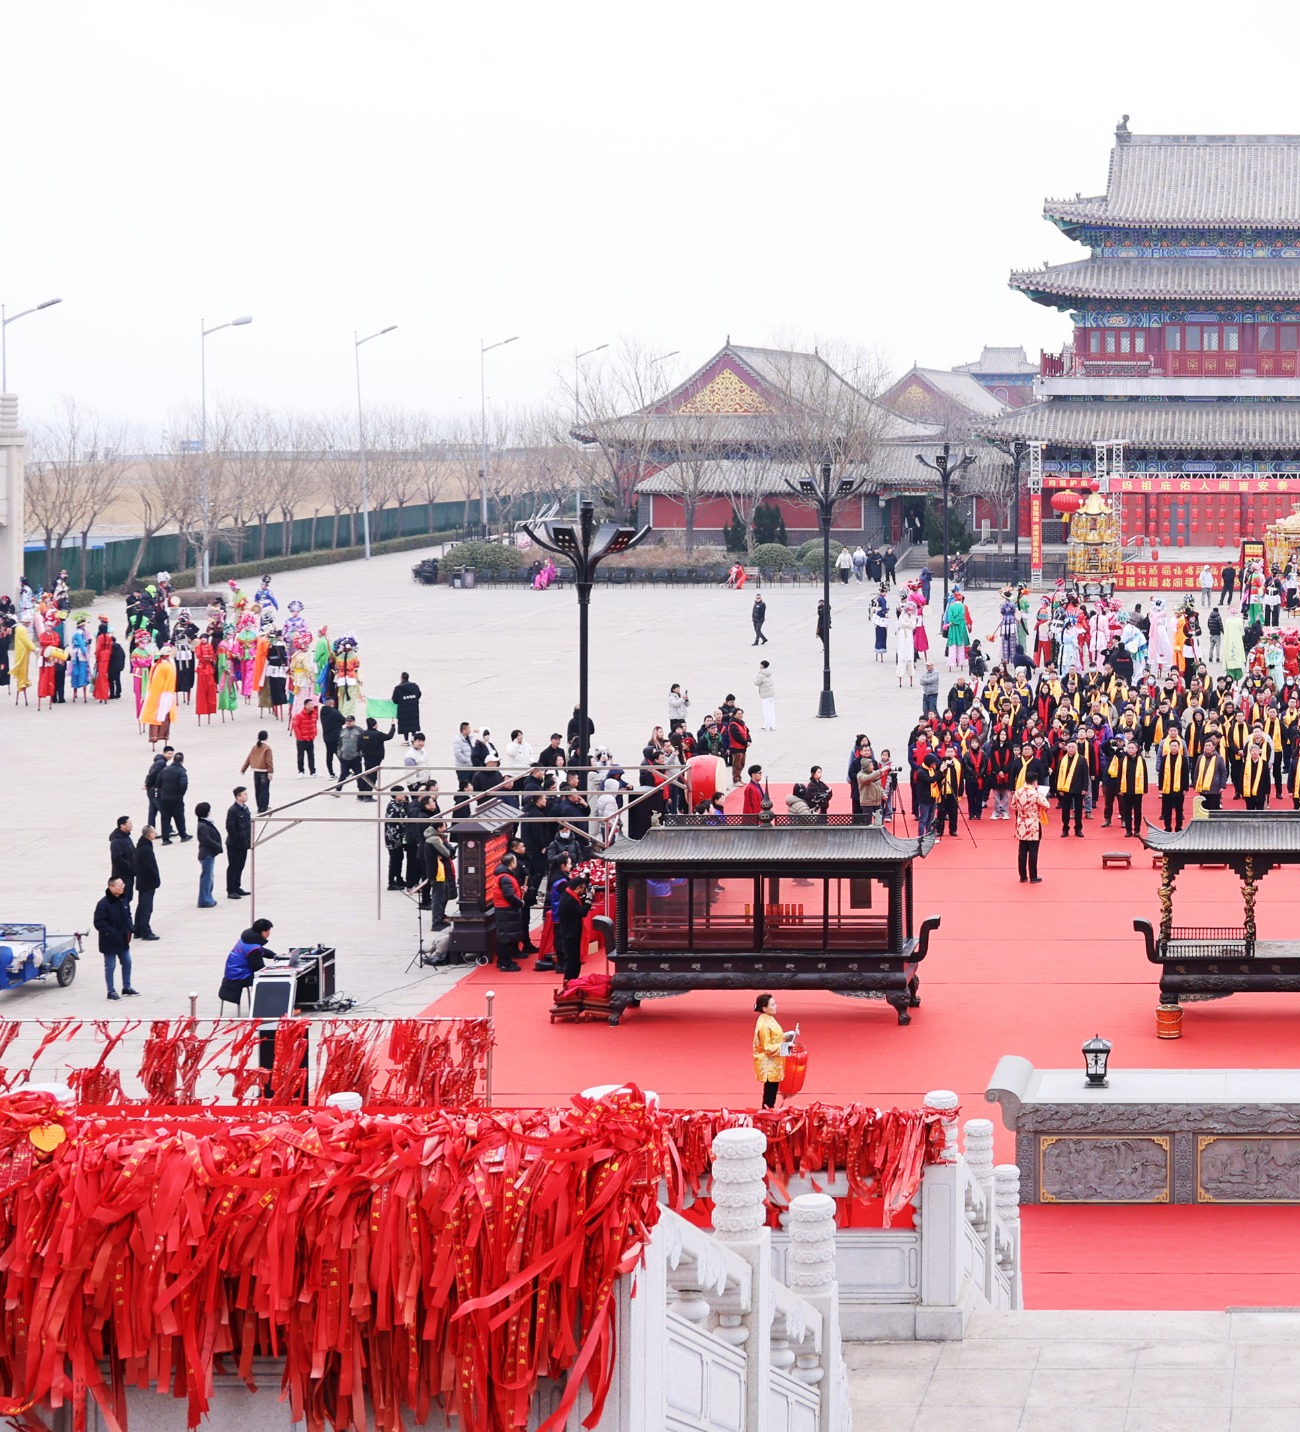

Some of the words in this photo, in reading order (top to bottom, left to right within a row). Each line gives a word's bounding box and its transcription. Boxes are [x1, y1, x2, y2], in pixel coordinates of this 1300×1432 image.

[1048, 479, 1088, 487] 妈祖护佑
[1121, 481, 1288, 491] 妈祖庇佑人间皆安泰
